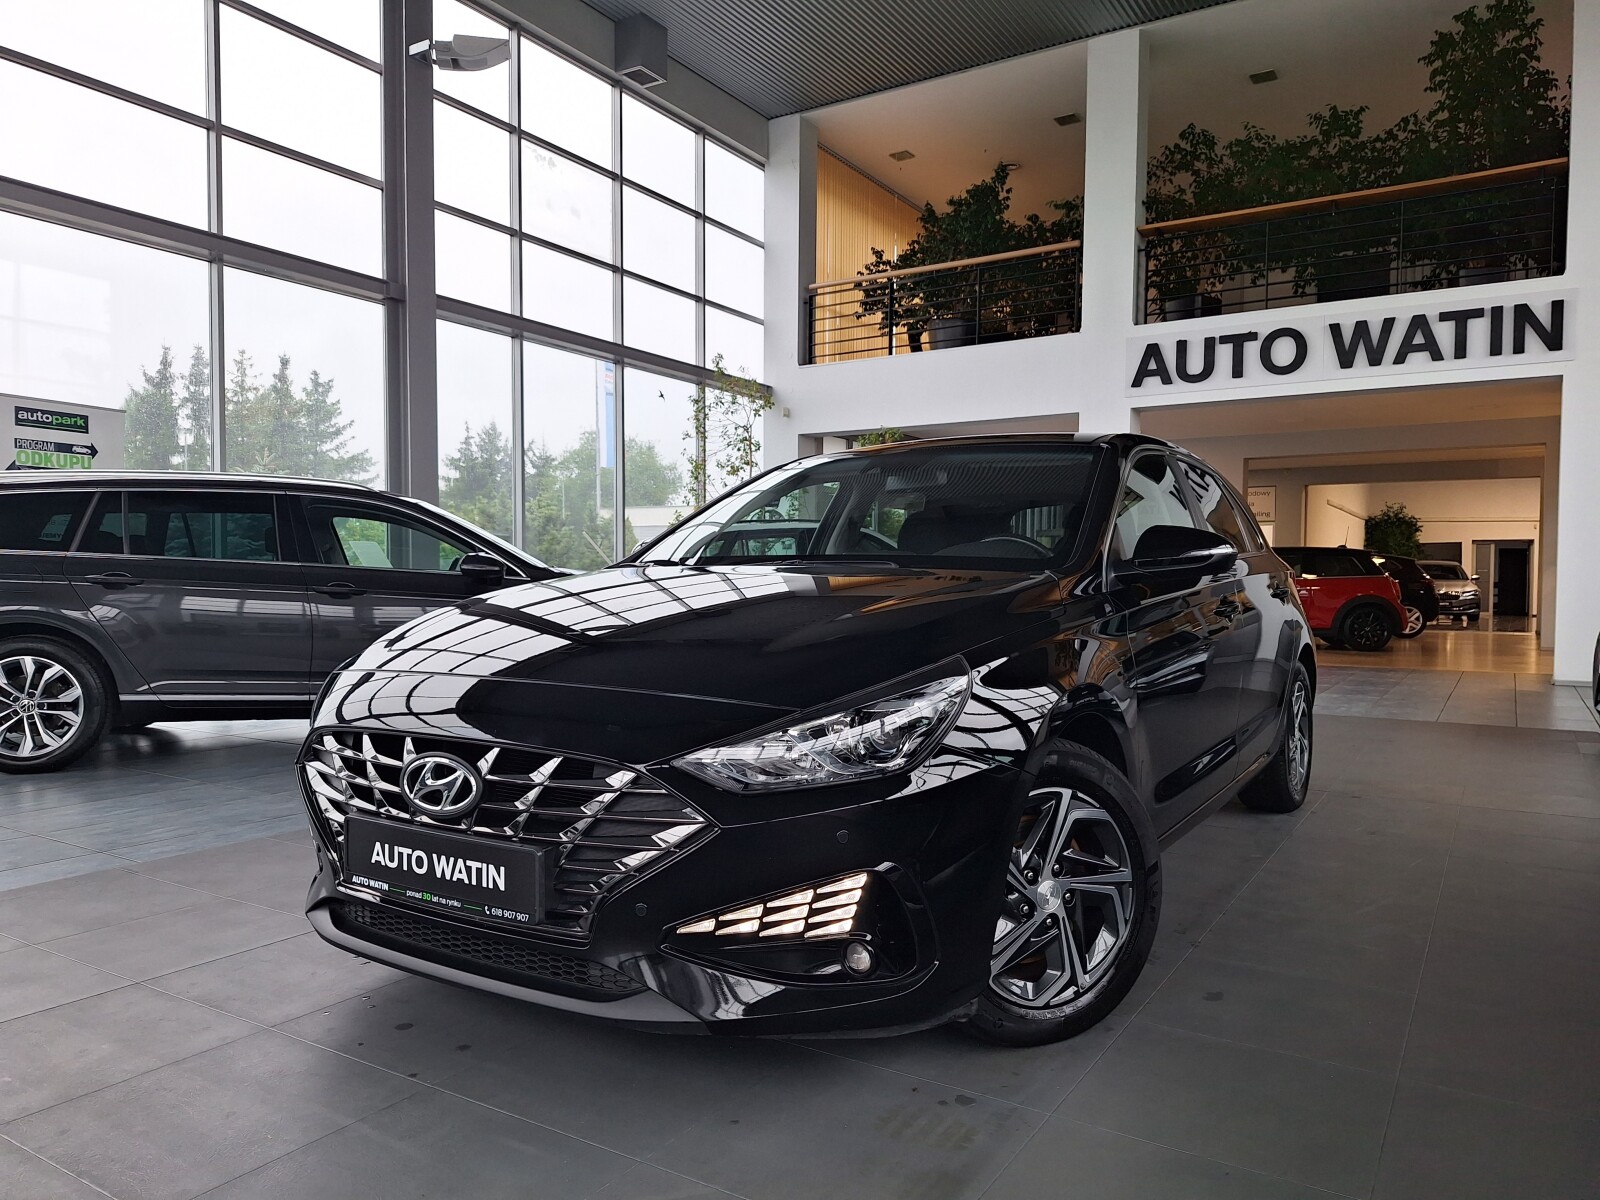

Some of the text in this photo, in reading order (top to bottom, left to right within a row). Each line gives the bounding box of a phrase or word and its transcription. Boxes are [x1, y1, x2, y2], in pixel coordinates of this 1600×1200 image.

[1130, 299, 1565, 388] AUTO WATIN
[17, 410, 86, 427] autopark
[16, 438, 55, 452] PROGRAM
[15, 449, 92, 470] ODKUPU
[371, 841, 506, 892] AUTO WATIN
[351, 874, 389, 891] AUTO WATIN
[406, 890, 422, 899] ponad
[422, 892, 431, 901] 30
[431, 894, 439, 903] lat
[446, 899, 462, 908] rynku
[491, 907, 529, 922] 618 907 907
